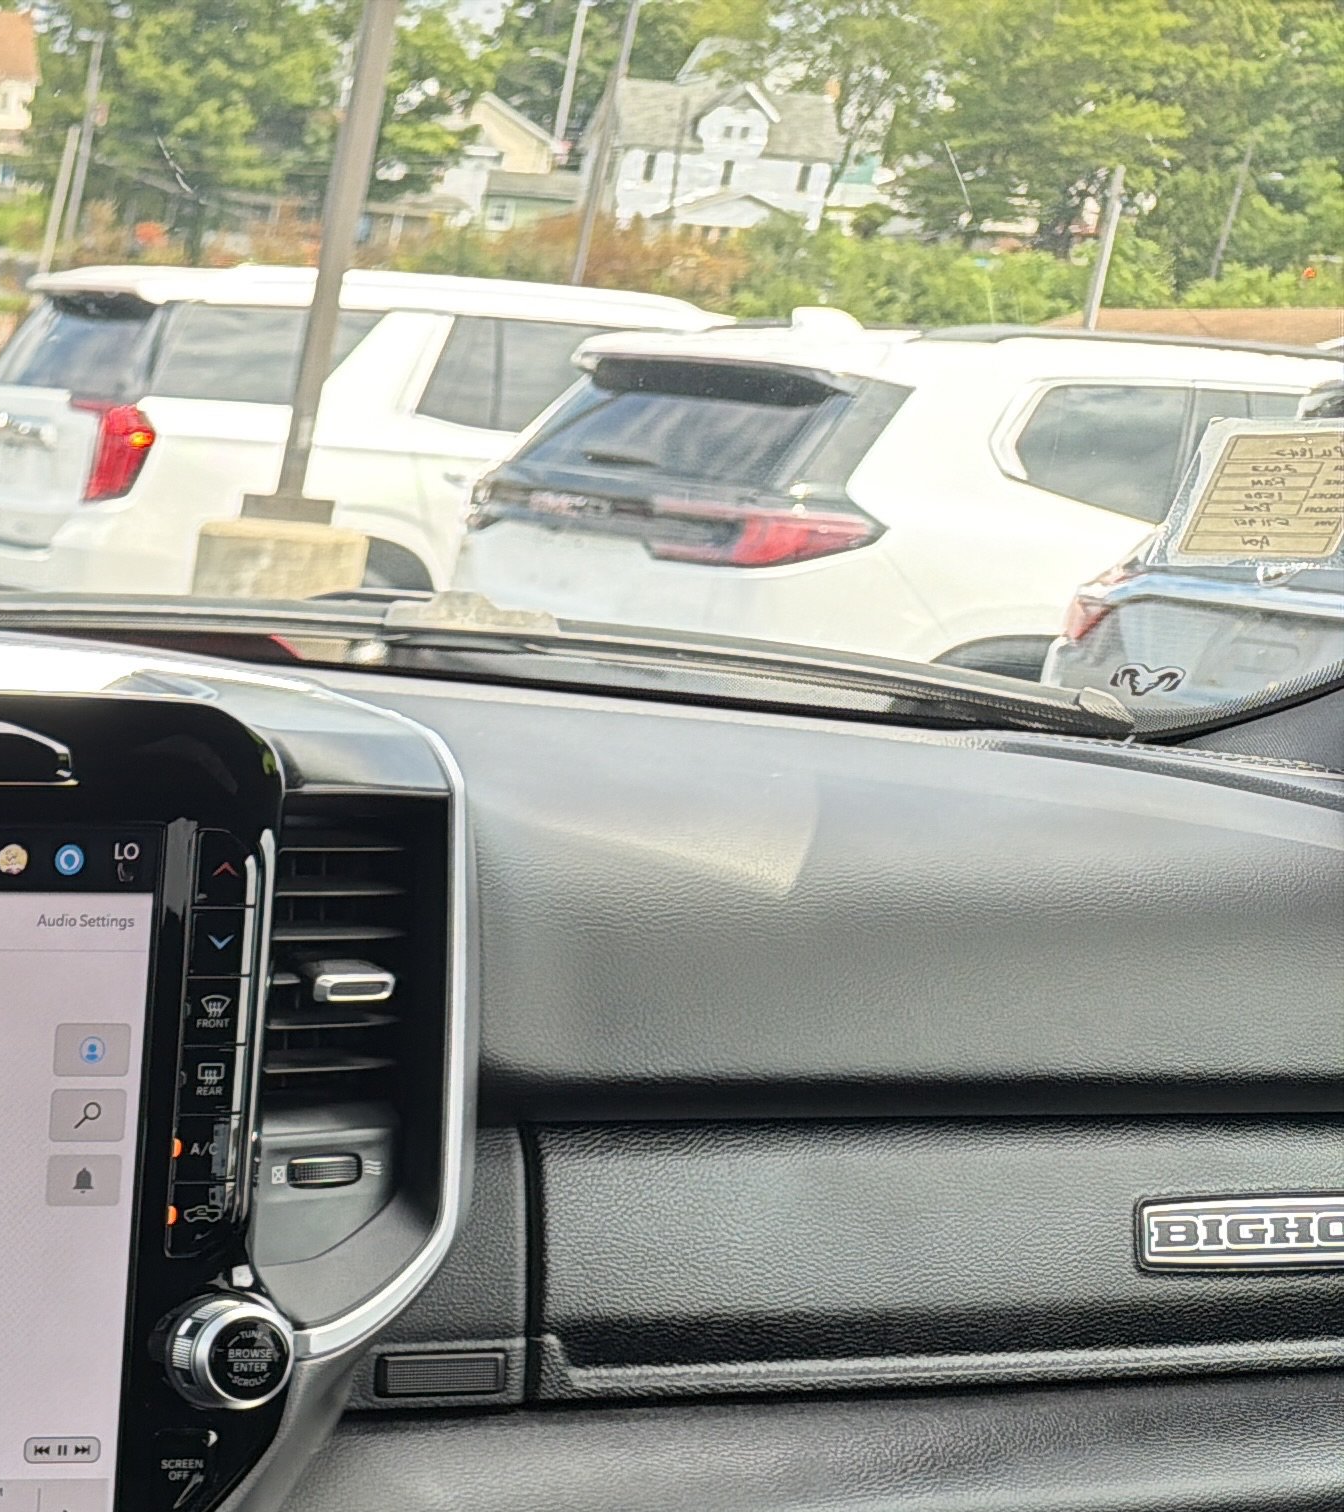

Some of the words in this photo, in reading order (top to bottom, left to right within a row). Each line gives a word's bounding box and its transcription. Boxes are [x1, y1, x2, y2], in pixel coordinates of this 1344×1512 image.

[114, 843, 140, 860] LO
[37, 913, 76, 929] Audio
[79, 913, 135, 931] Settings
[196, 1018, 230, 1029] FRONT
[196, 1086, 223, 1096] REAR
[190, 1143, 219, 1156] A/C
[227, 1349, 273, 1359] BROWSE
[233, 1363, 268, 1372] ENTER
[231, 1376, 267, 1387] SCROLL
[161, 1459, 204, 1469] SCREEN
[168, 1471, 190, 1481] OFF
